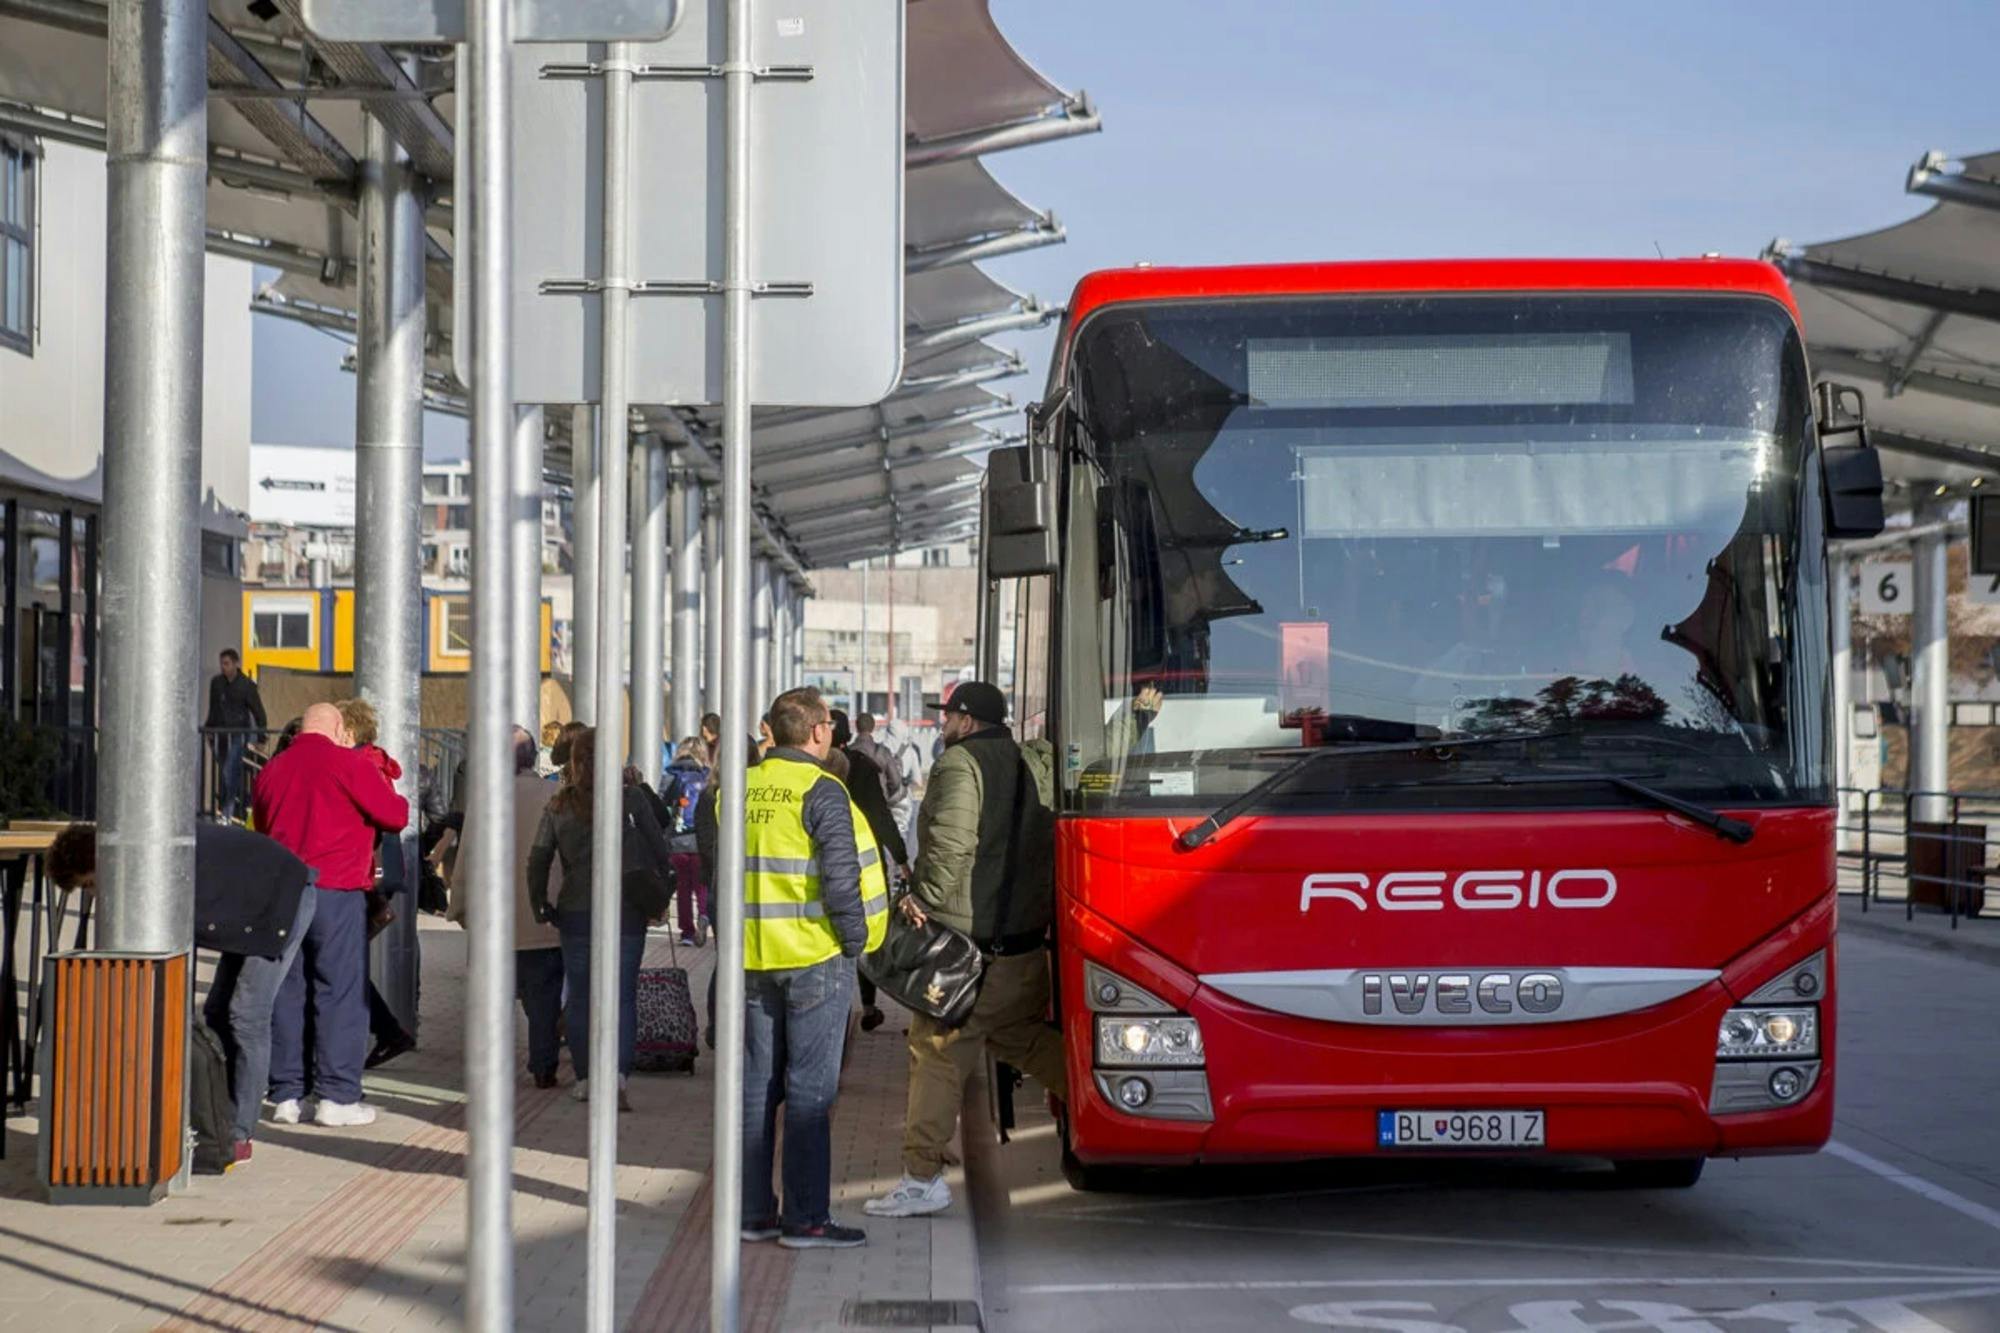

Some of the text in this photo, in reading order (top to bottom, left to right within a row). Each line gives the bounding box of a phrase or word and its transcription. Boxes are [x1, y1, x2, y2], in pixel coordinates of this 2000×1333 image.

[1878, 572, 1898, 602] 6
[744, 808, 776, 824] AFF
[1300, 869, 1618, 913] REGIO
[1363, 973, 1564, 1016] IVECO
[1399, 1115, 1433, 1142] BL
